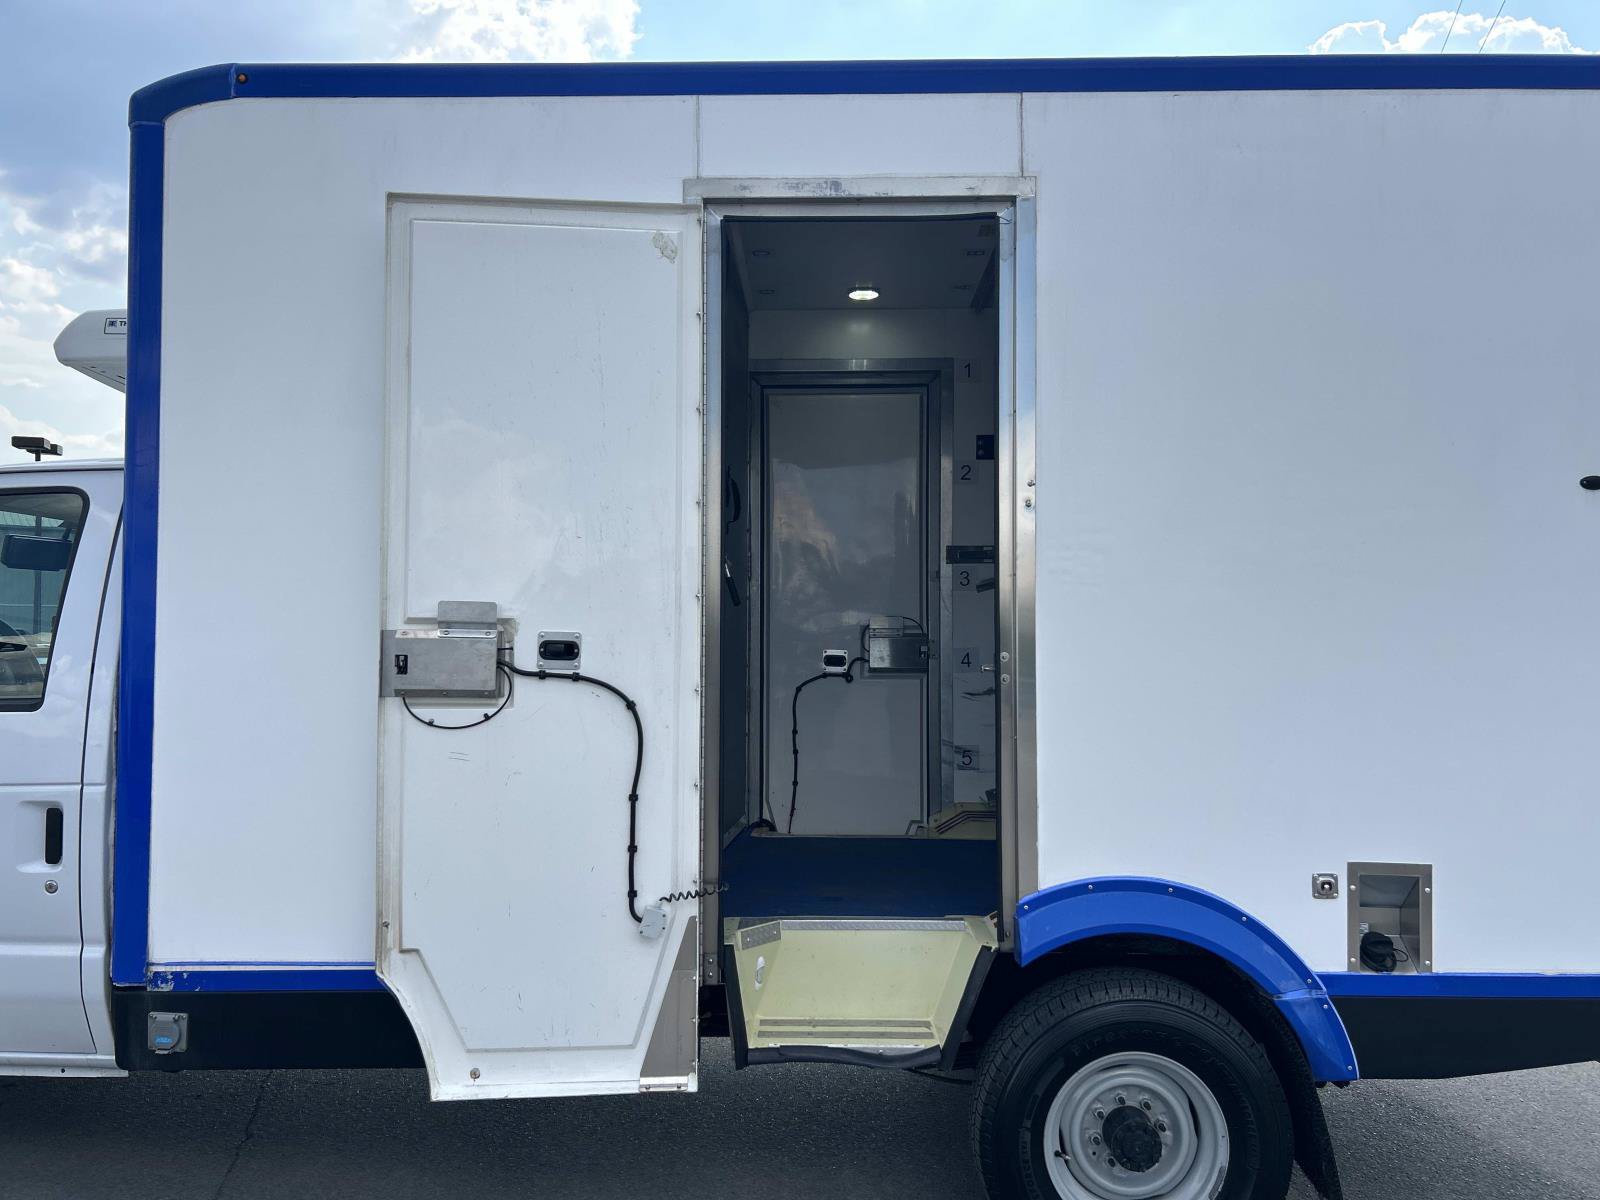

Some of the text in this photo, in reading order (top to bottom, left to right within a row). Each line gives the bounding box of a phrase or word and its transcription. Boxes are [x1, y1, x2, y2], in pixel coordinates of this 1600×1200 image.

[964, 363, 971, 377] 1
[961, 465, 972, 481] 2
[959, 571, 970, 587] 3
[961, 652, 971, 667] 4
[962, 750, 972, 766] 5
